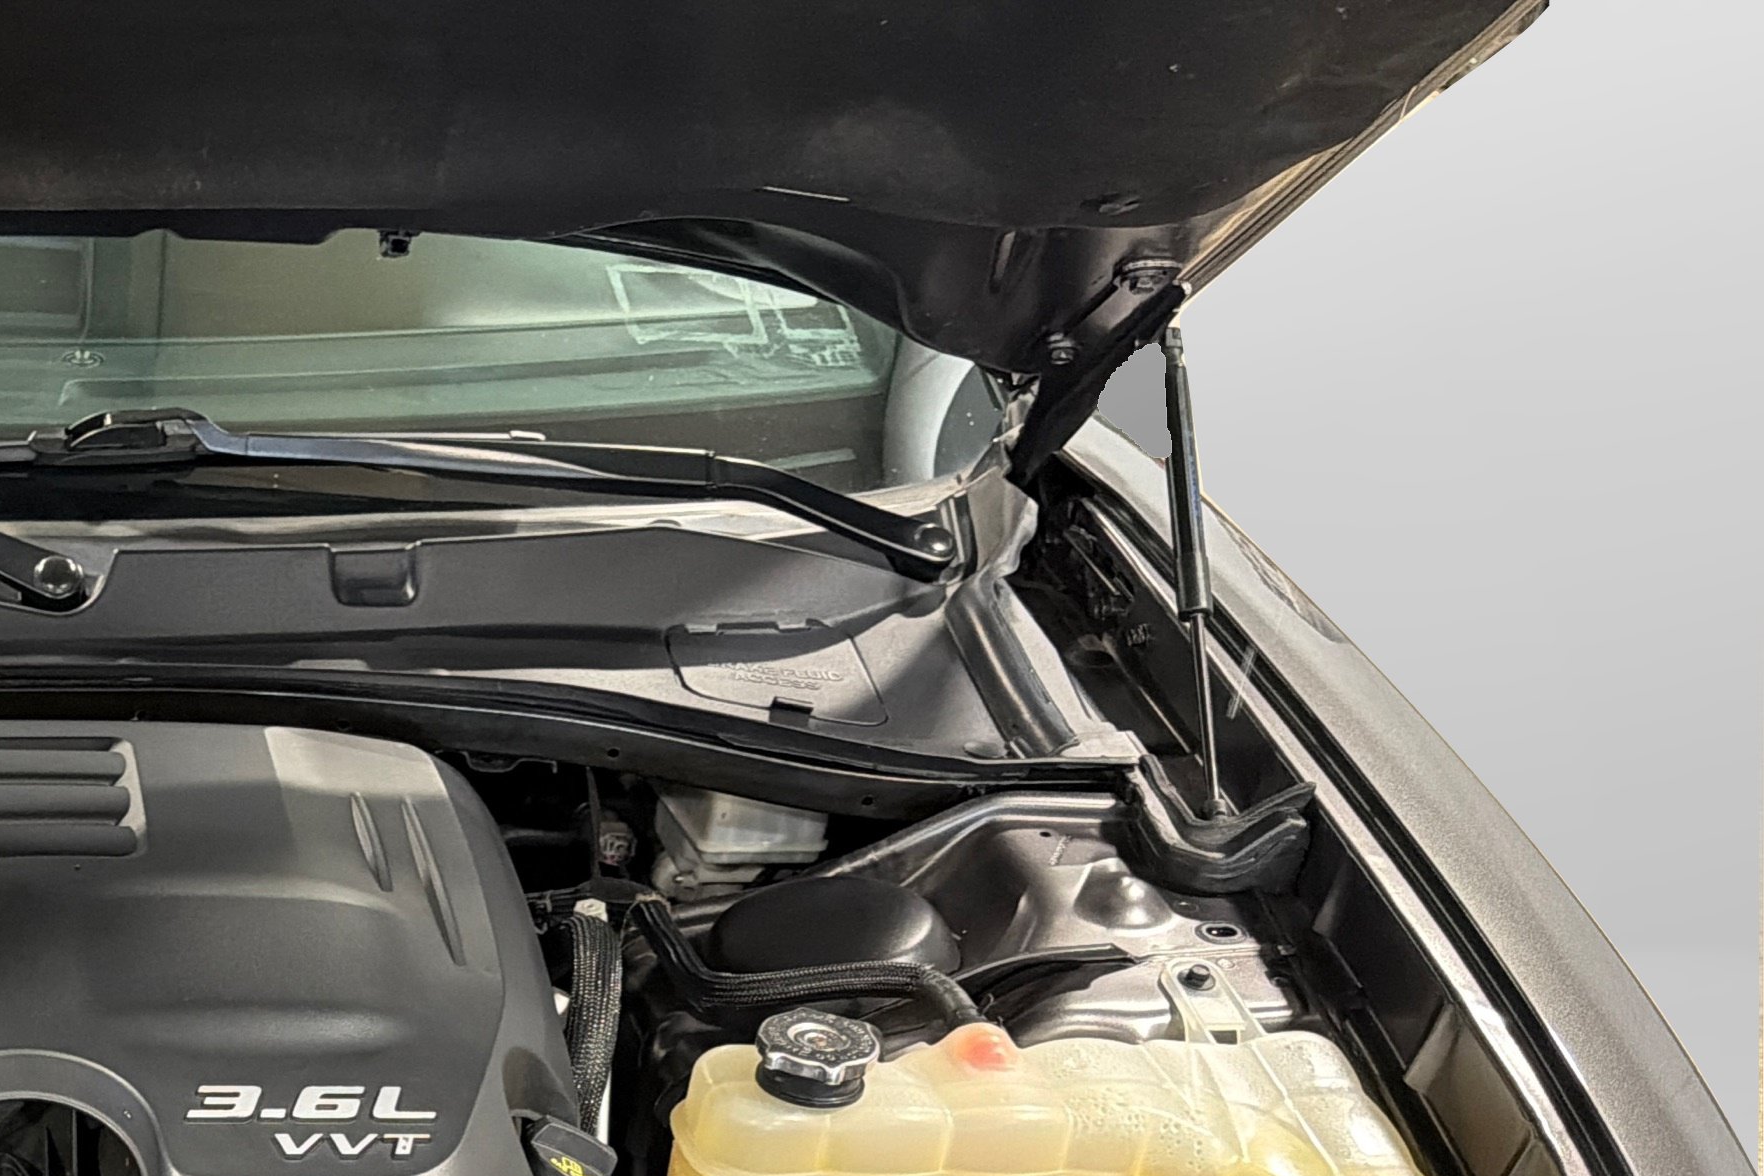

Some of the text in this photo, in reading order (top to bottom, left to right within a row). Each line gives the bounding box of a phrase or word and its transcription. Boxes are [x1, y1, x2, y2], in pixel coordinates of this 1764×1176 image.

[735, 672, 821, 690] ACCESS
[781, 669, 843, 682] FLUID
[185, 1084, 437, 1122] 3.6L
[273, 1132, 432, 1159] VVT
